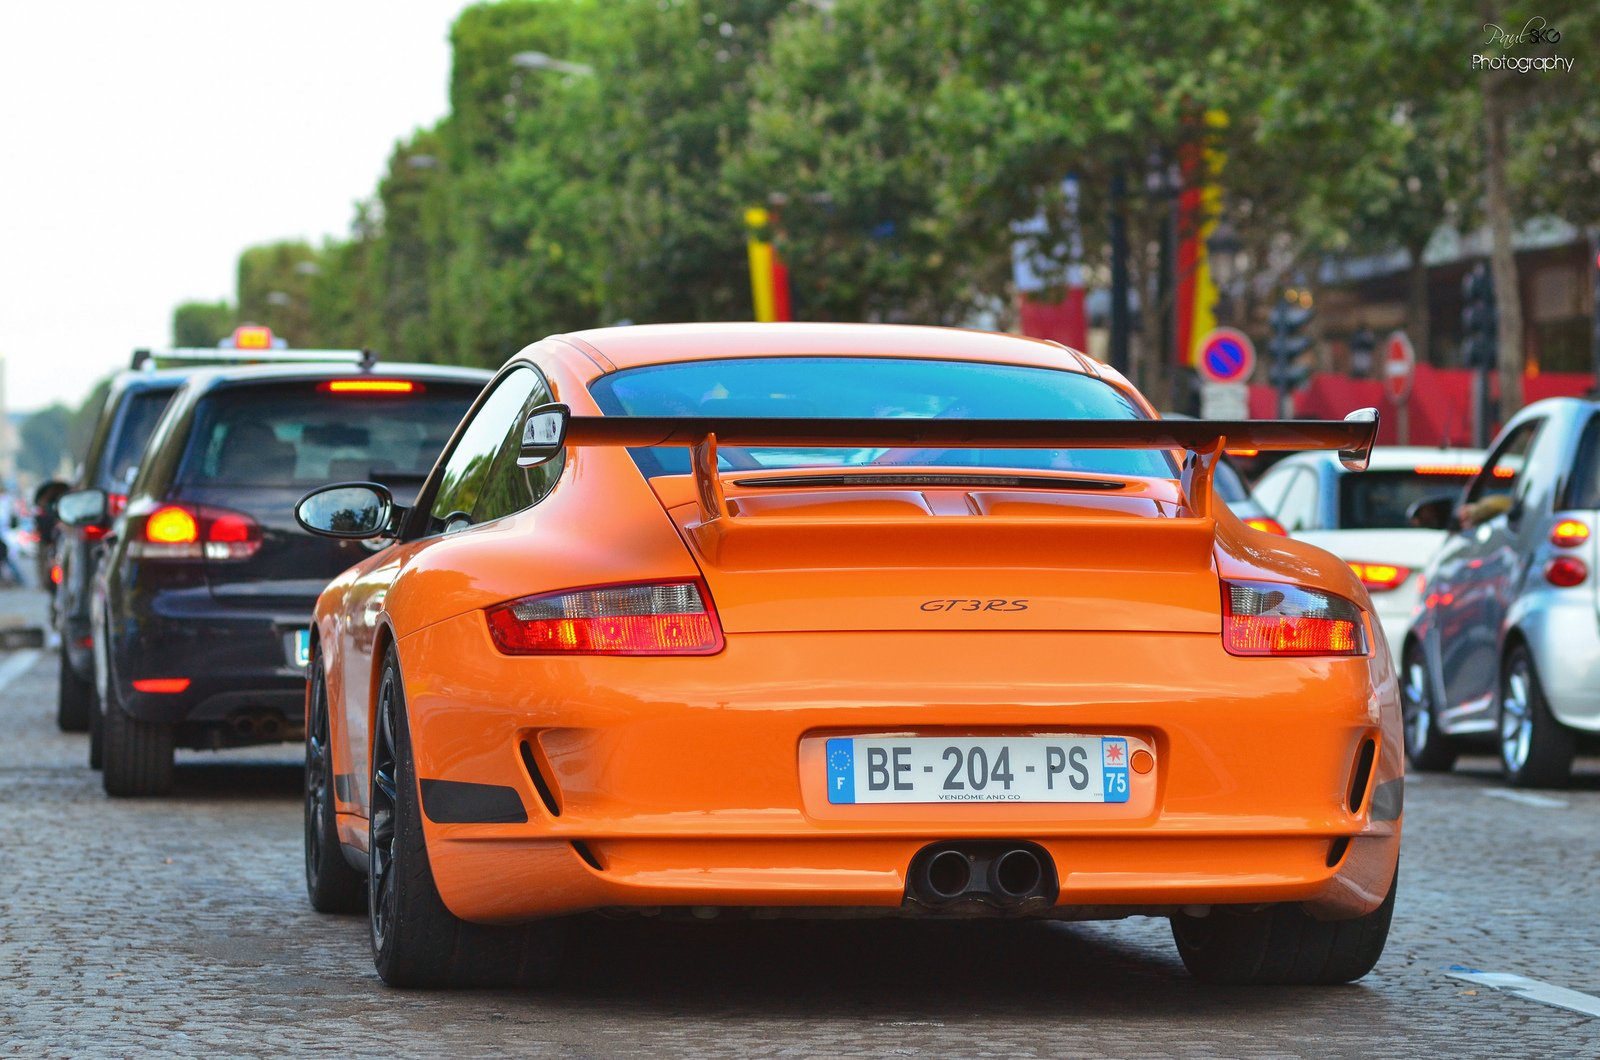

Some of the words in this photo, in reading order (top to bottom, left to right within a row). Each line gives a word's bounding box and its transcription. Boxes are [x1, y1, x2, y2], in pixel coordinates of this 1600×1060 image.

[920, 599, 1029, 612] GT3RS
[837, 777, 846, 790] F
[1105, 773, 1127, 793] 75
